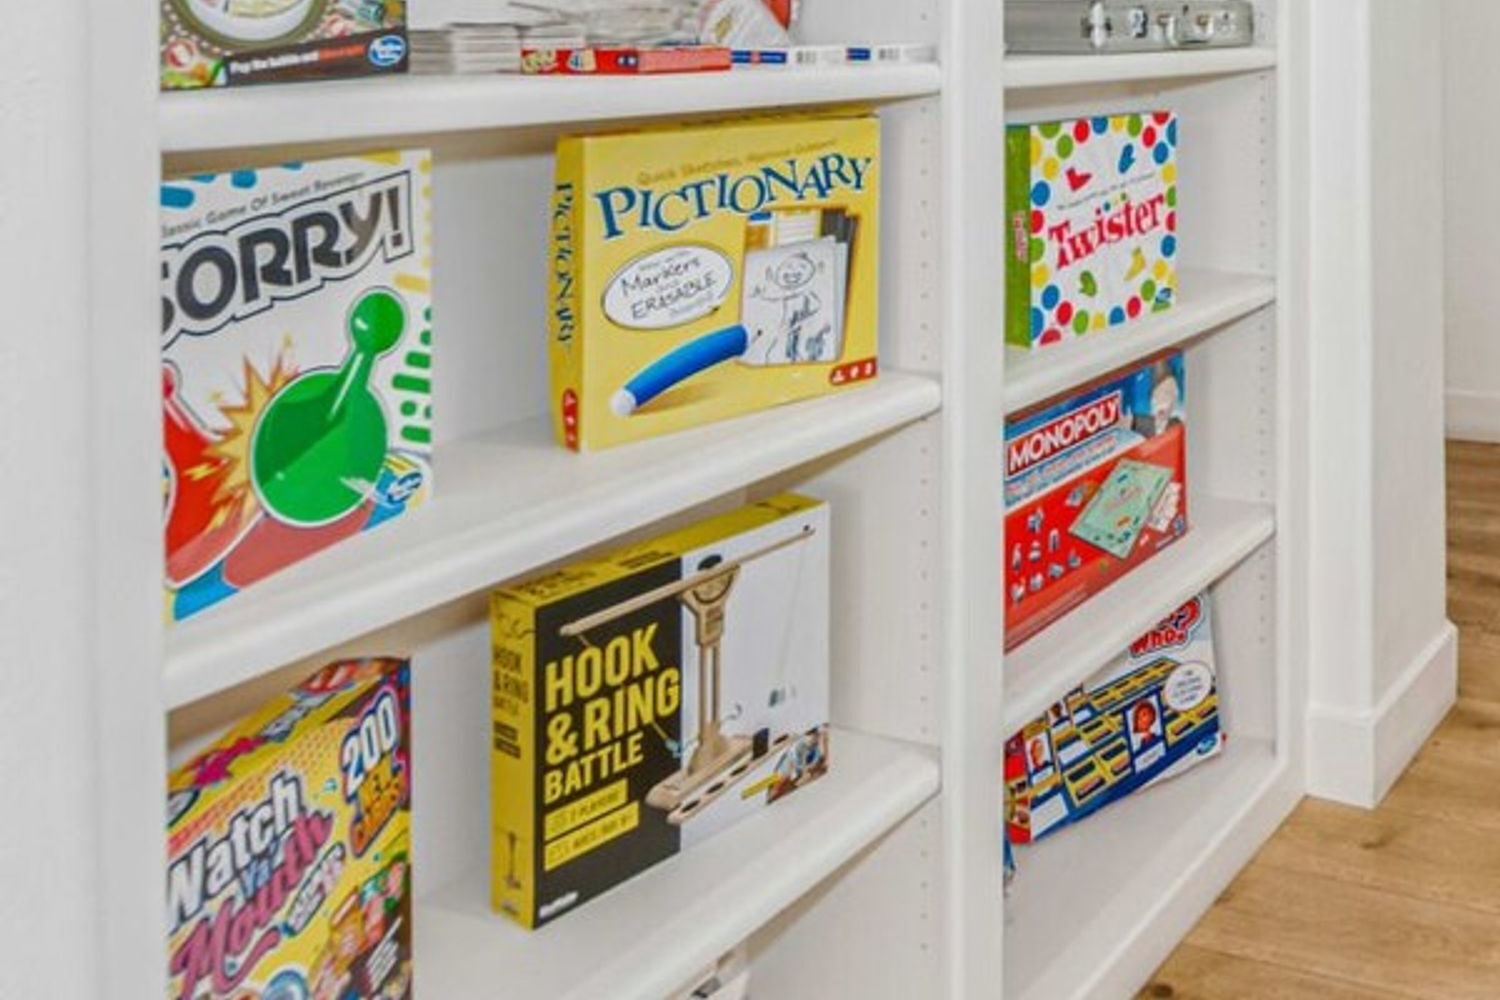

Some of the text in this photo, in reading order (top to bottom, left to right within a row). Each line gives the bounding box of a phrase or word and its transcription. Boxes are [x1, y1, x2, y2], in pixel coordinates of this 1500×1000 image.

[596, 153, 872, 239] PICTIONARY
[1049, 193, 1164, 270] Twister
[1009, 397, 1119, 473] MONOPOLY
[545, 622, 659, 714] HOOK
[341, 692, 398, 800] 200
[545, 713, 579, 765] &
[585, 667, 680, 752] RING
[544, 731, 644, 805] BATTLE
